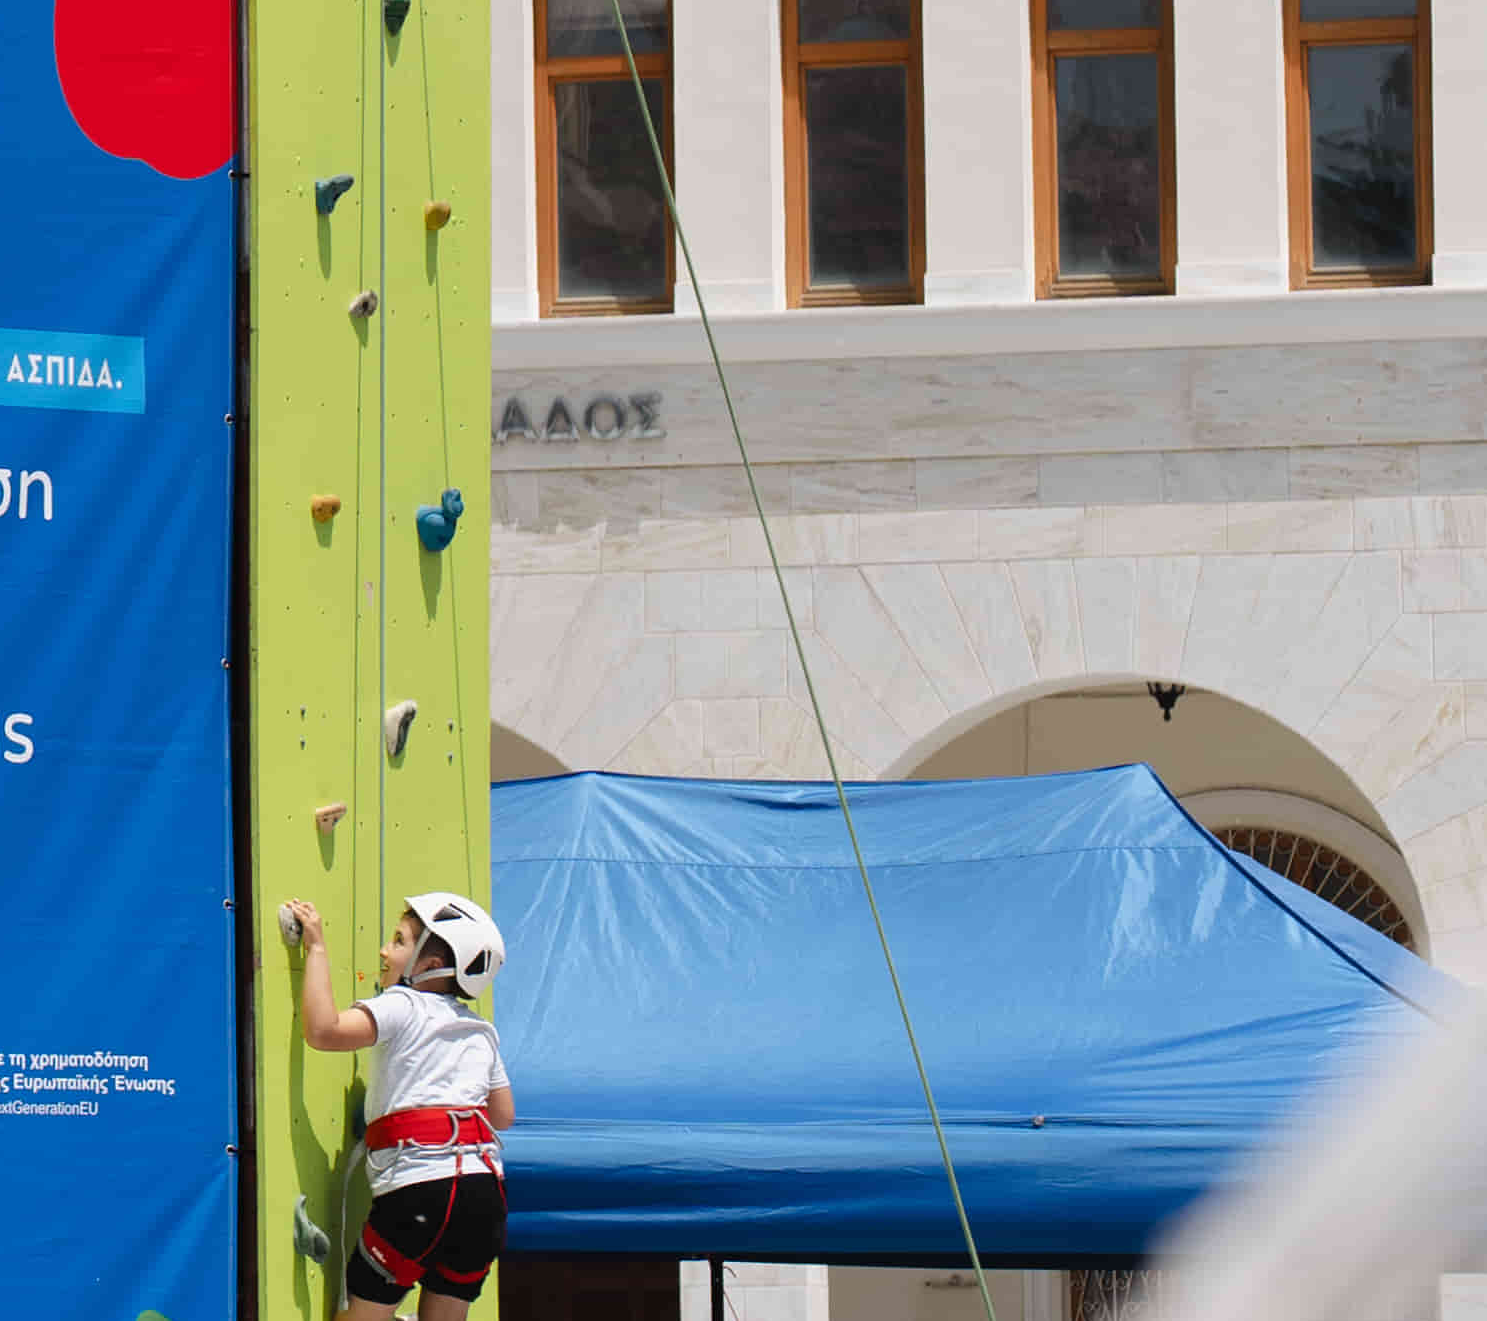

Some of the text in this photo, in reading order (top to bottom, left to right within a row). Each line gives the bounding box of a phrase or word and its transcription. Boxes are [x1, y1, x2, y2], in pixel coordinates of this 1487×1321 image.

[7, 354, 122, 389] ΑΣΠΙΔΑ.
[8, 1052, 26, 1070] τη
[29, 1050, 149, 1072] χρηματοδότηση
